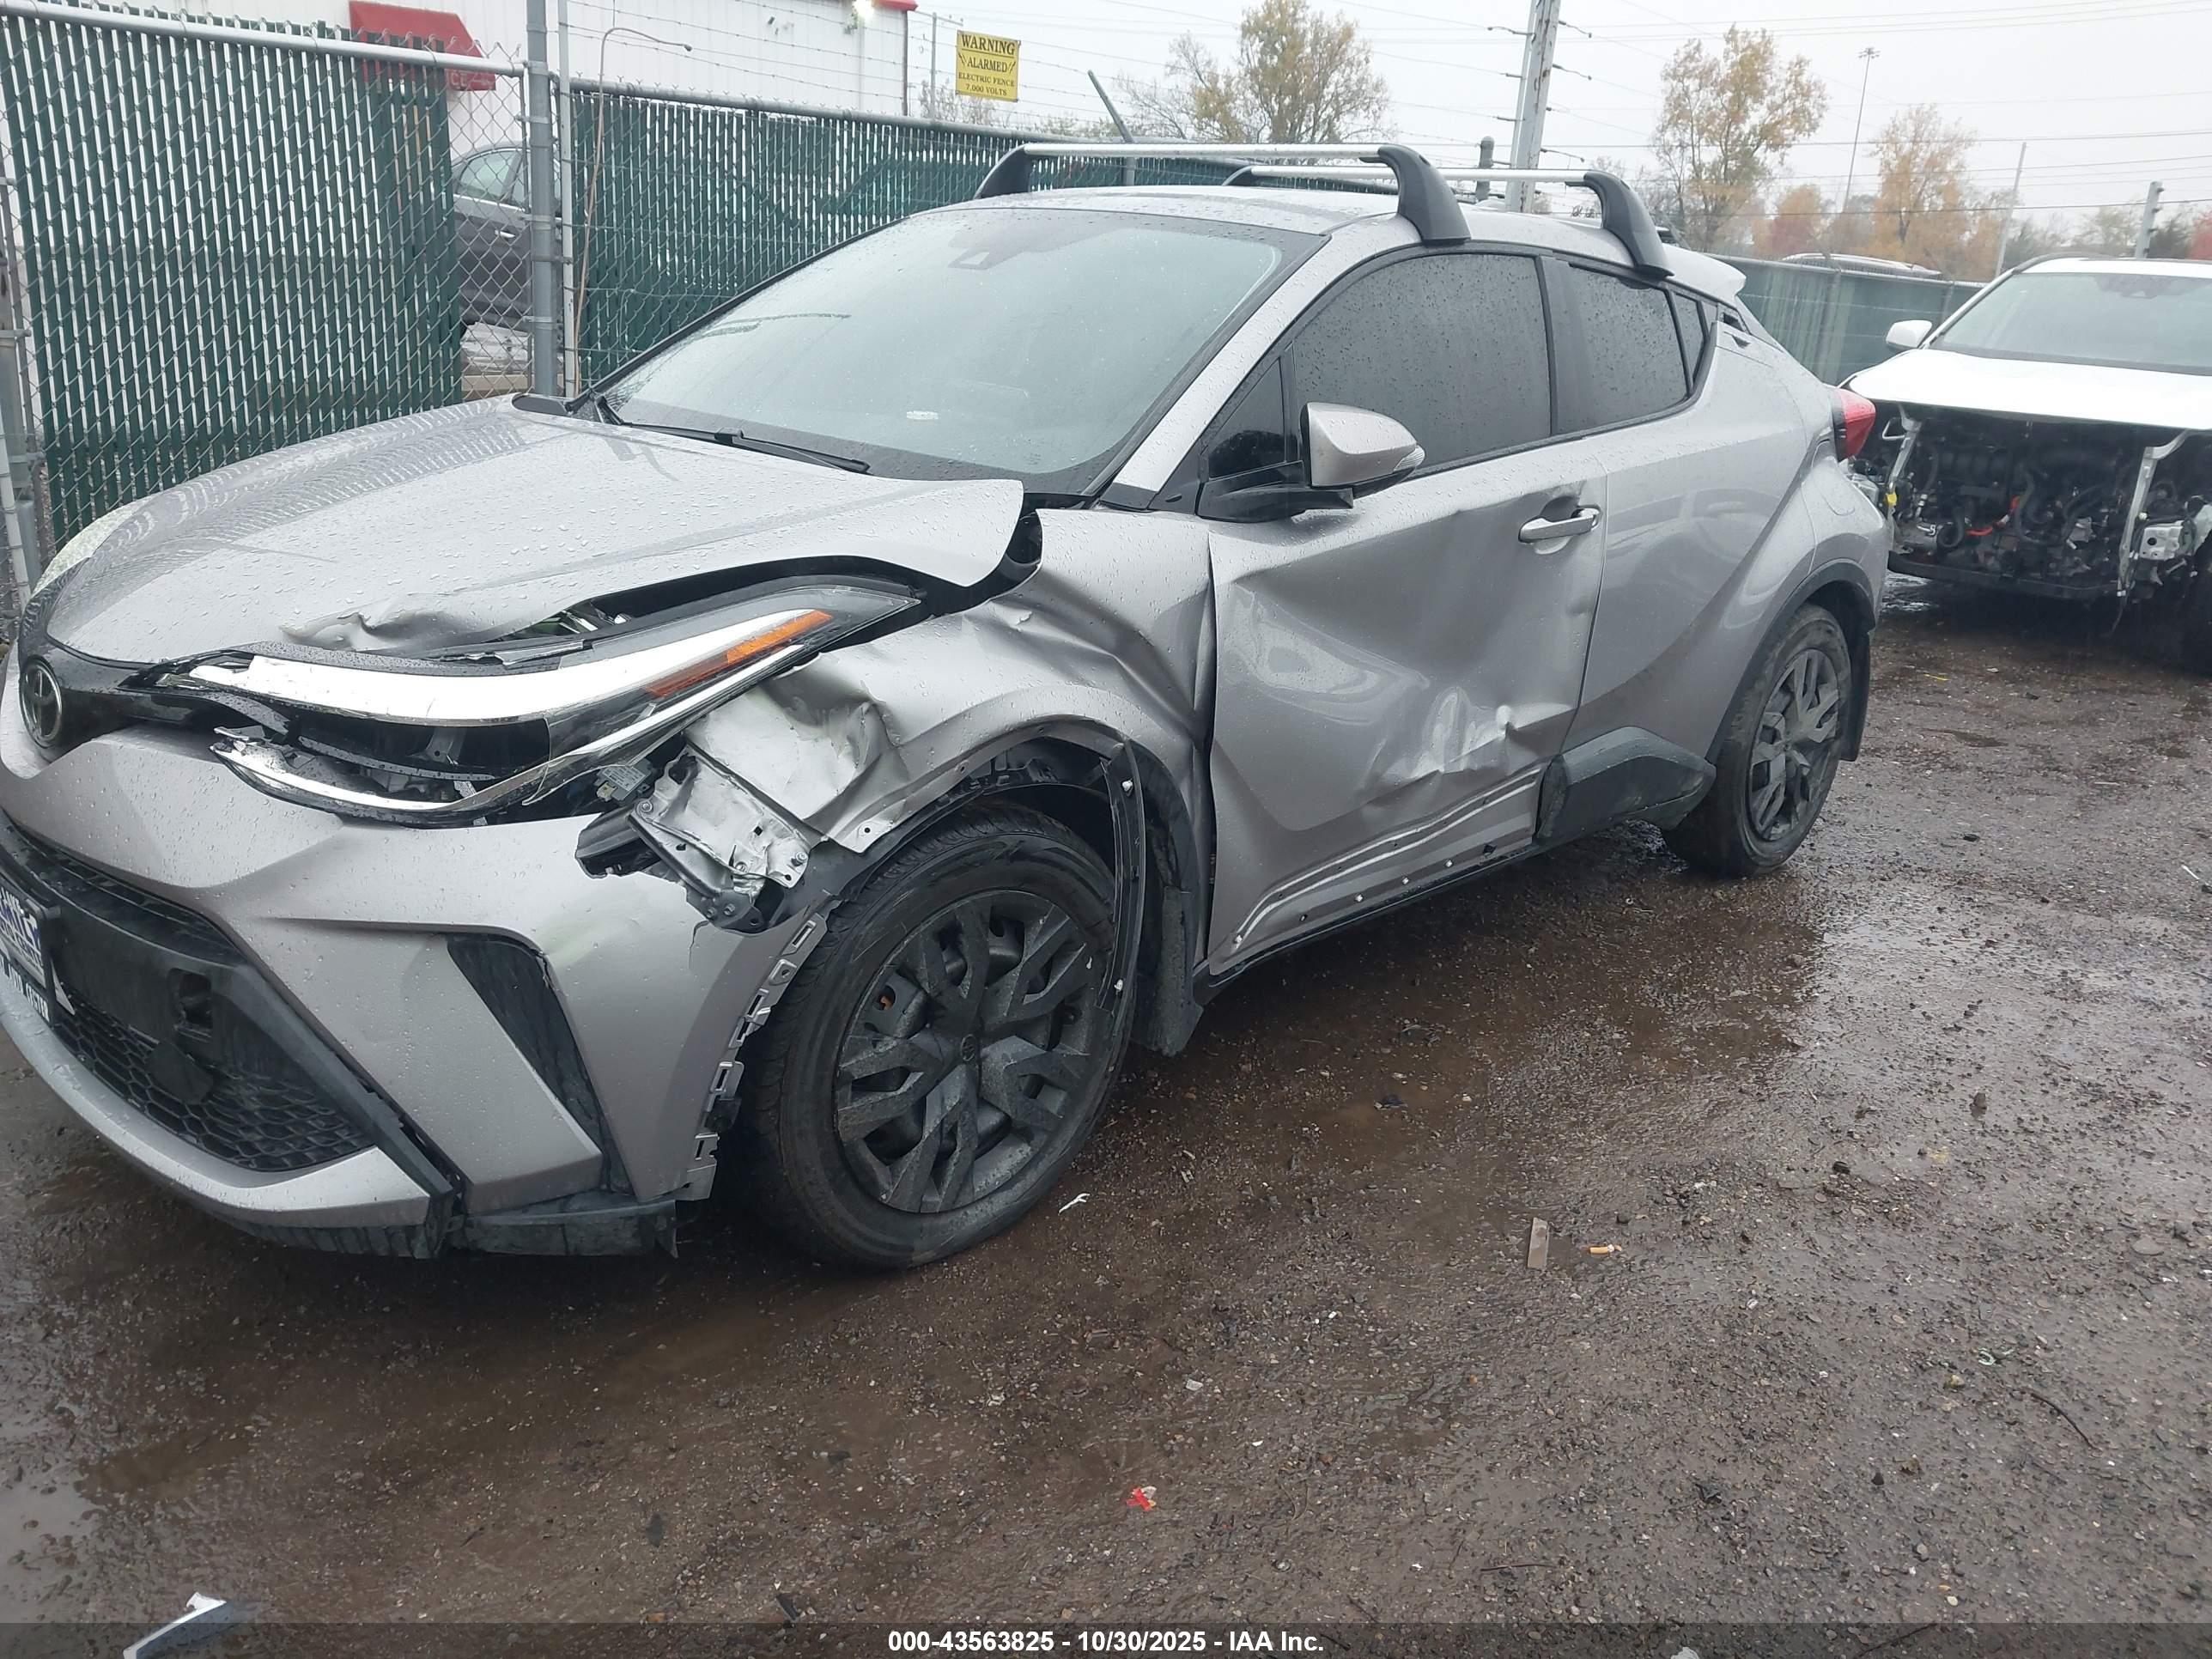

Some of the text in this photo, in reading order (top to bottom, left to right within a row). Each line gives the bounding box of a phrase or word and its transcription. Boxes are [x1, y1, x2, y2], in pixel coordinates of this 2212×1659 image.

[962, 34, 1015, 55] WARNING
[967, 57, 1007, 72] ALARMED
[958, 72, 1015, 87] ELECTRIC FENCE
[965, 83, 1007, 96] 7,000 VOLTS
